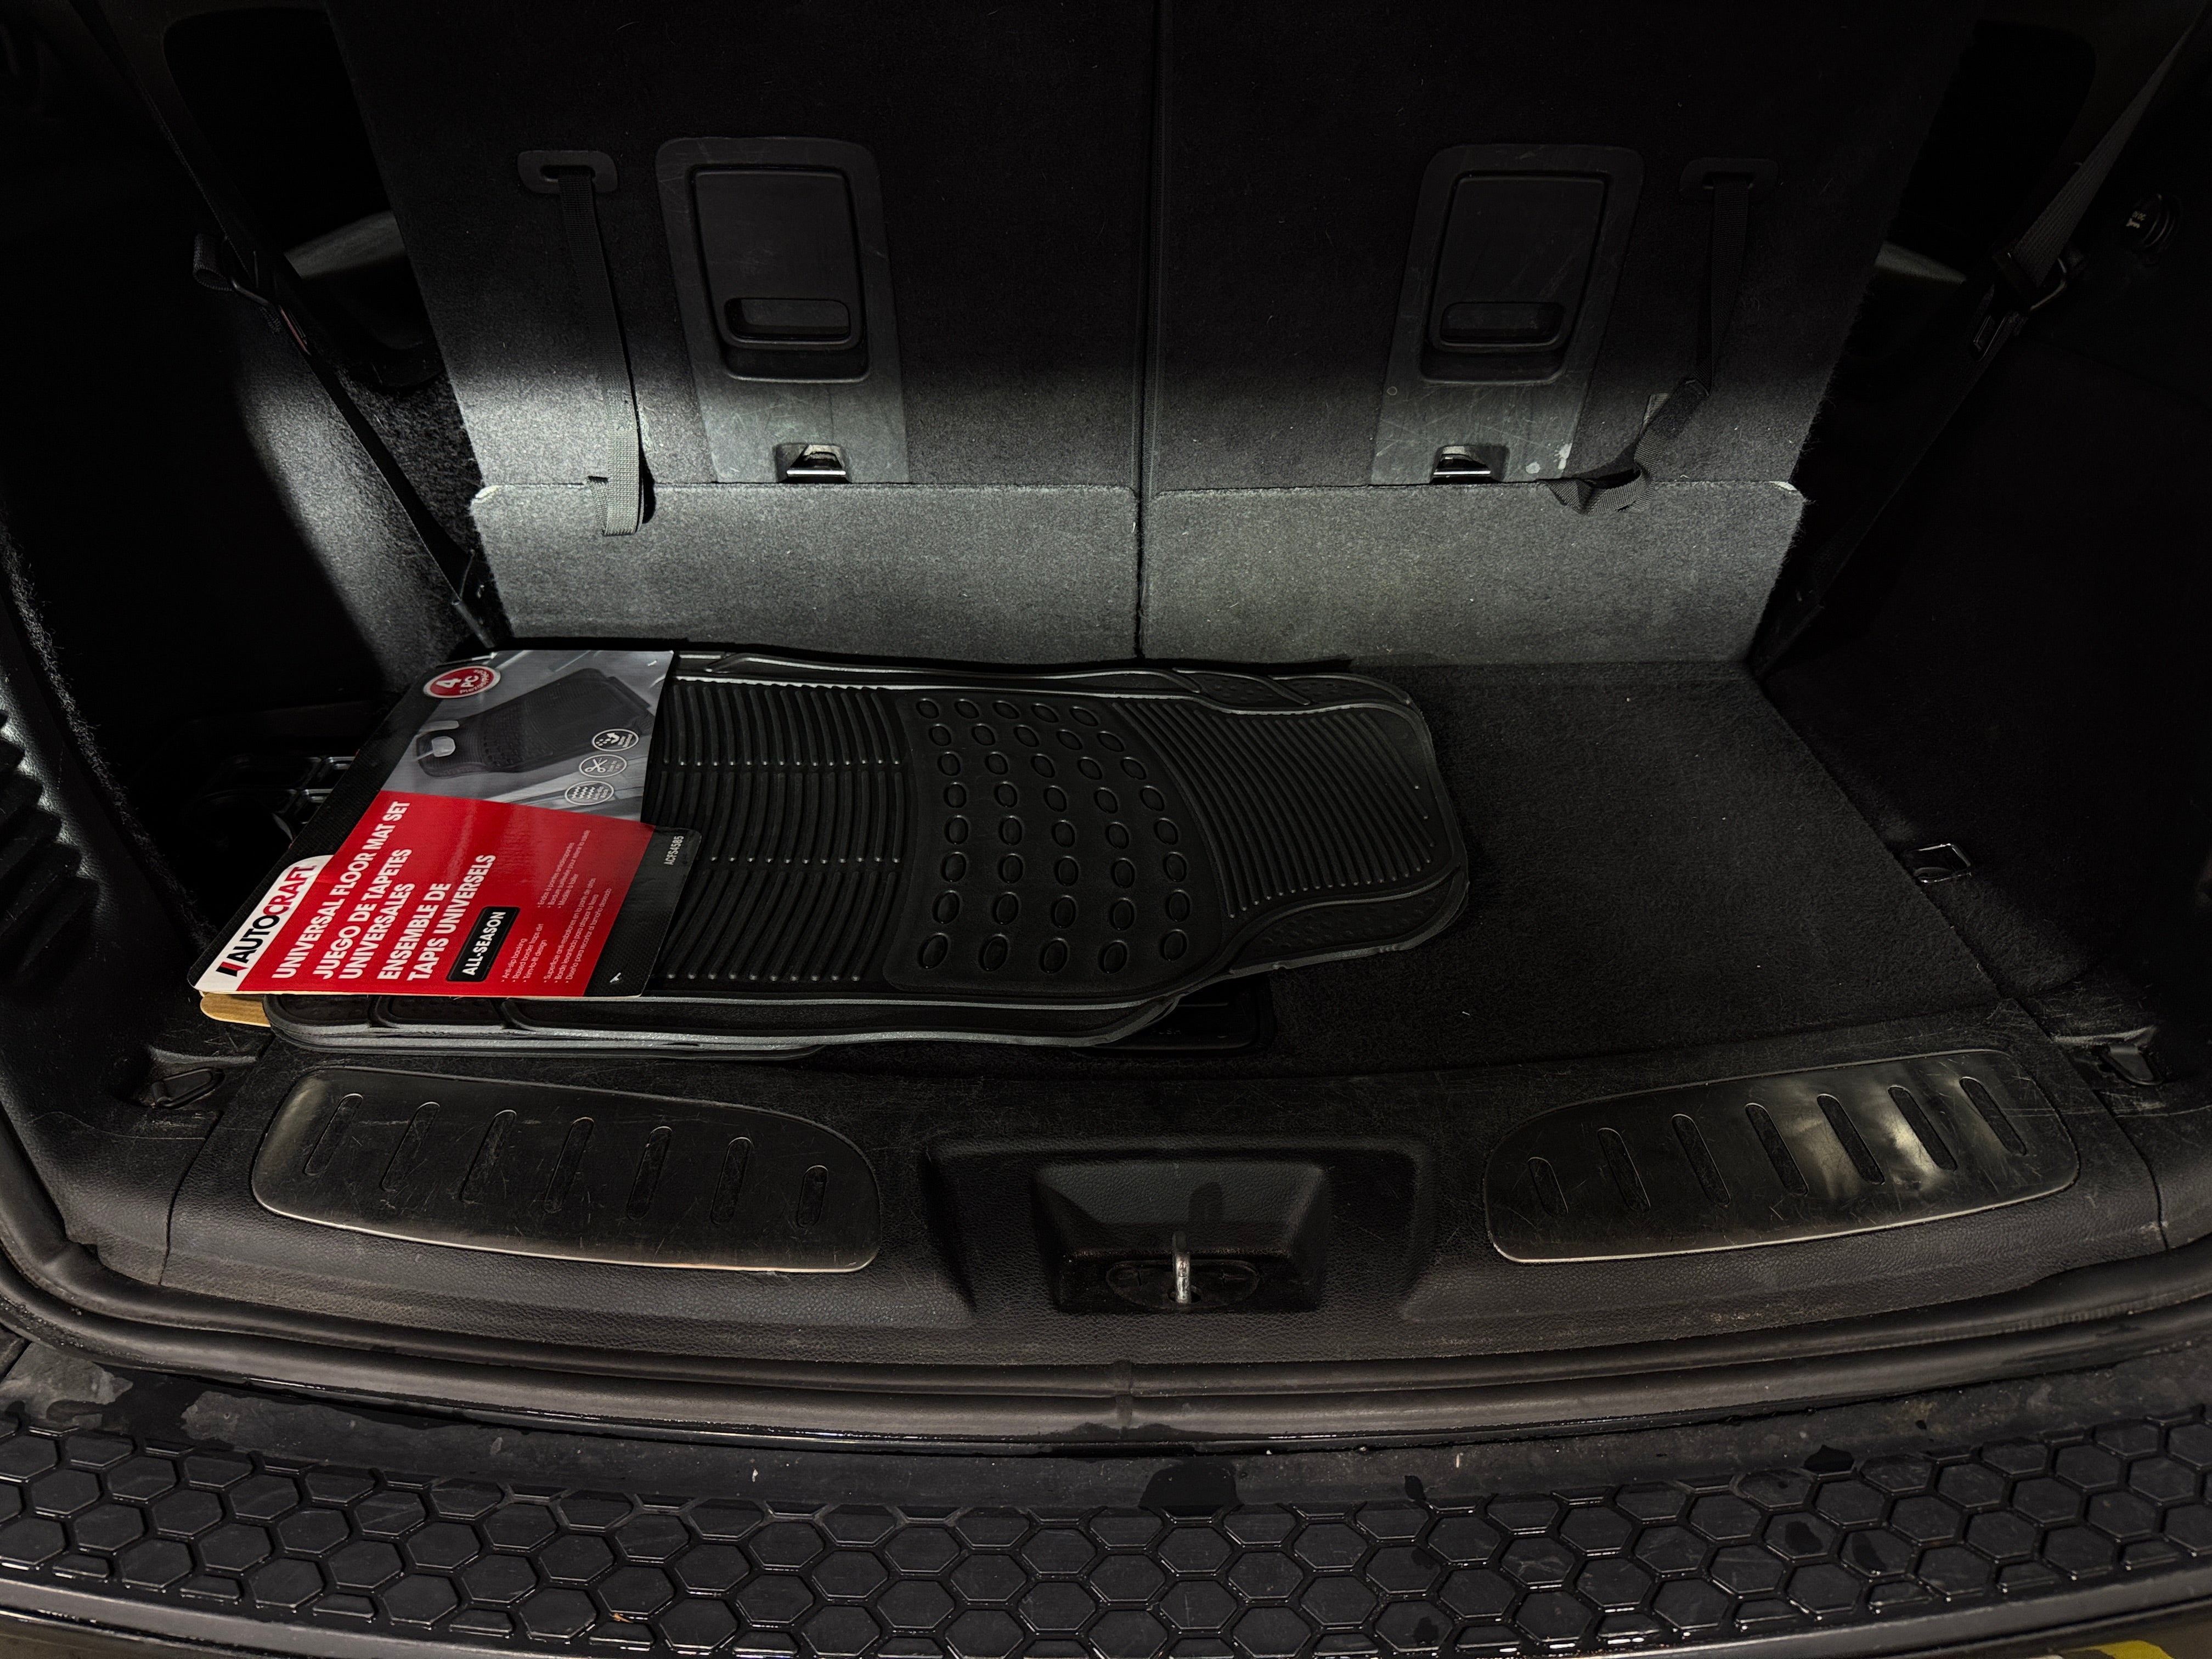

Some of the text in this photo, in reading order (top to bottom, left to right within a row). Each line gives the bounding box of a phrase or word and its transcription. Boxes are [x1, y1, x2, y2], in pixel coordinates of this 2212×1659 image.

[436, 678, 462, 689] 4
[460, 675, 479, 687] PC
[663, 836, 684, 865] ACFS4585
[226, 866, 315, 964] AUTOCRAFT
[271, 801, 410, 978] UNIVERSAL FLOOR MAT SET
[312, 849, 412, 979] JUEGO DE TAPETES
[338, 883, 415, 979] UNIVERSALES
[377, 883, 452, 979] ENSEMBLE DE
[407, 855, 496, 981] TAPIS UNIVERSELS
[462, 911, 506, 975] ALL-SEASON
[502, 938, 528, 979] Anti-slip backing
[512, 962, 526, 979] Raised
[521, 945, 534, 961] border
[529, 932, 540, 944] traps
[535, 939, 548, 956] design
[554, 964, 567, 979] Borde
[574, 928, 583, 939] para
[574, 950, 584, 962] para
